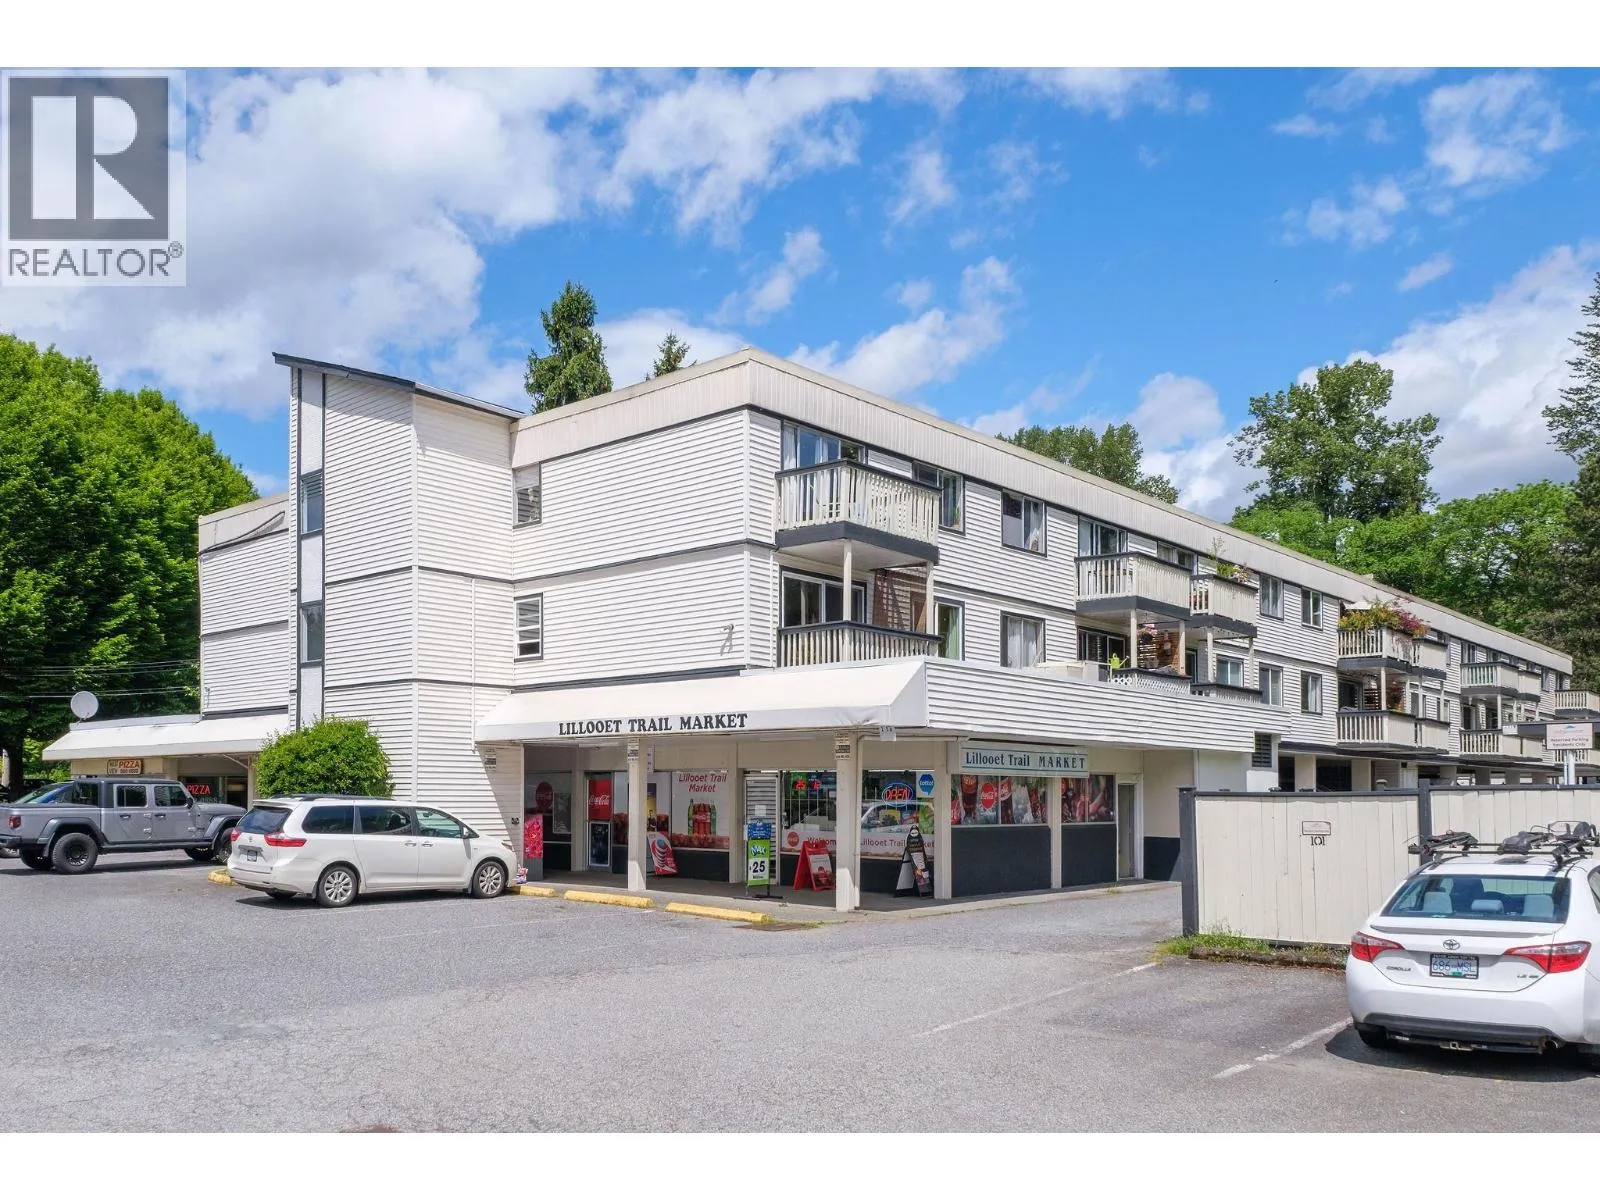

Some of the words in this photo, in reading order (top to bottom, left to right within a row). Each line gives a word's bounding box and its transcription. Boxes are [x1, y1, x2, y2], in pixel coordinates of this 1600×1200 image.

[559, 719, 622, 736] LILLOOET
[628, 717, 673, 733] TRAIL
[680, 713, 748, 730] MARKET
[118, 760, 140, 768] PIZZA
[966, 752, 1005, 765] Lillooet
[1008, 754, 1030, 767] Trail
[1039, 756, 1085, 769] MARKET
[679, 773, 708, 783] Lillooet
[710, 773, 727, 783] Trail
[187, 784, 211, 795] PIZZA
[688, 783, 716, 793] Market
[884, 786, 909, 801] OPEN
[1311, 836, 1326, 846] 101
